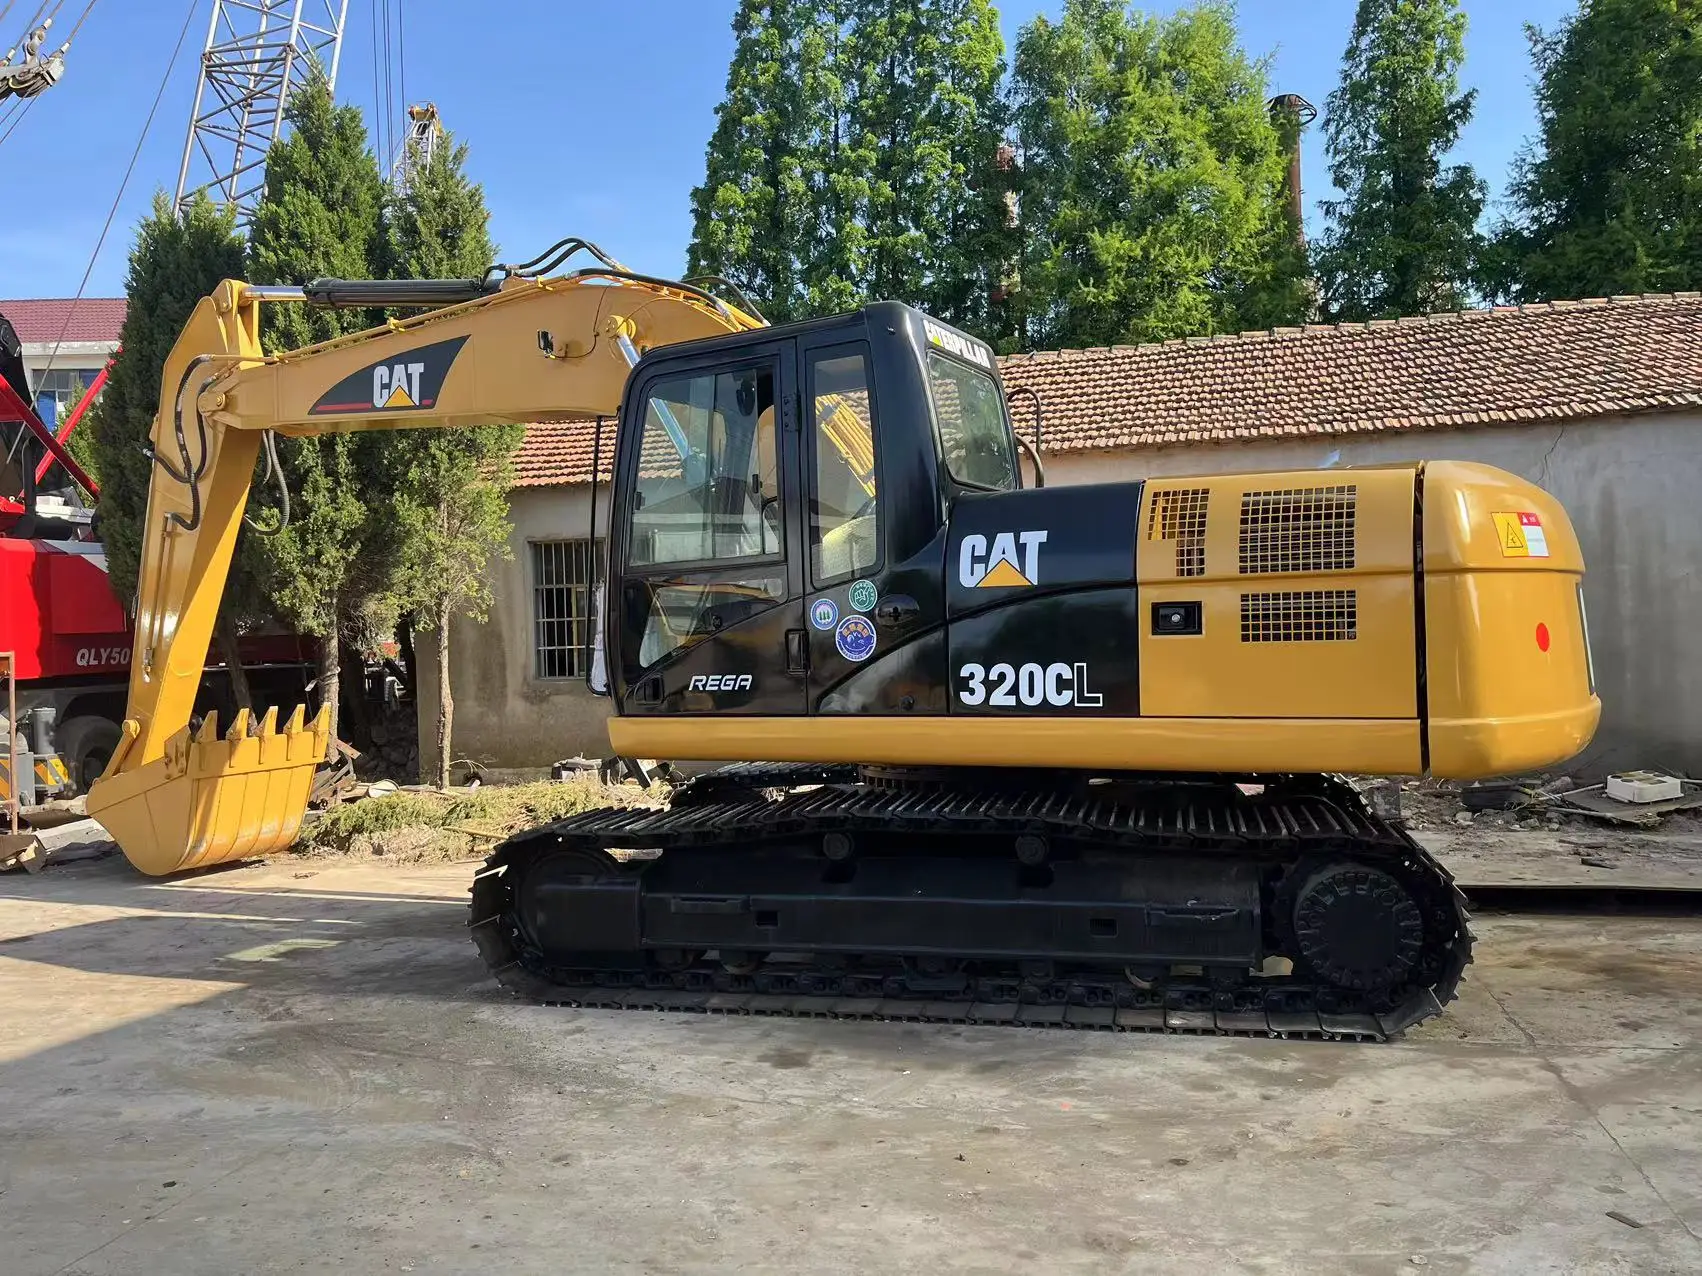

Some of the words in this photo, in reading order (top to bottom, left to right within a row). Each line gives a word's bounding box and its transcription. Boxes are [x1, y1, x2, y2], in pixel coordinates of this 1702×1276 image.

[373, 363, 424, 408] CAT
[959, 530, 1048, 588] CAT
[76, 647, 131, 667] QLY50
[688, 674, 753, 691] REGA
[959, 662, 1103, 707] 320CL
